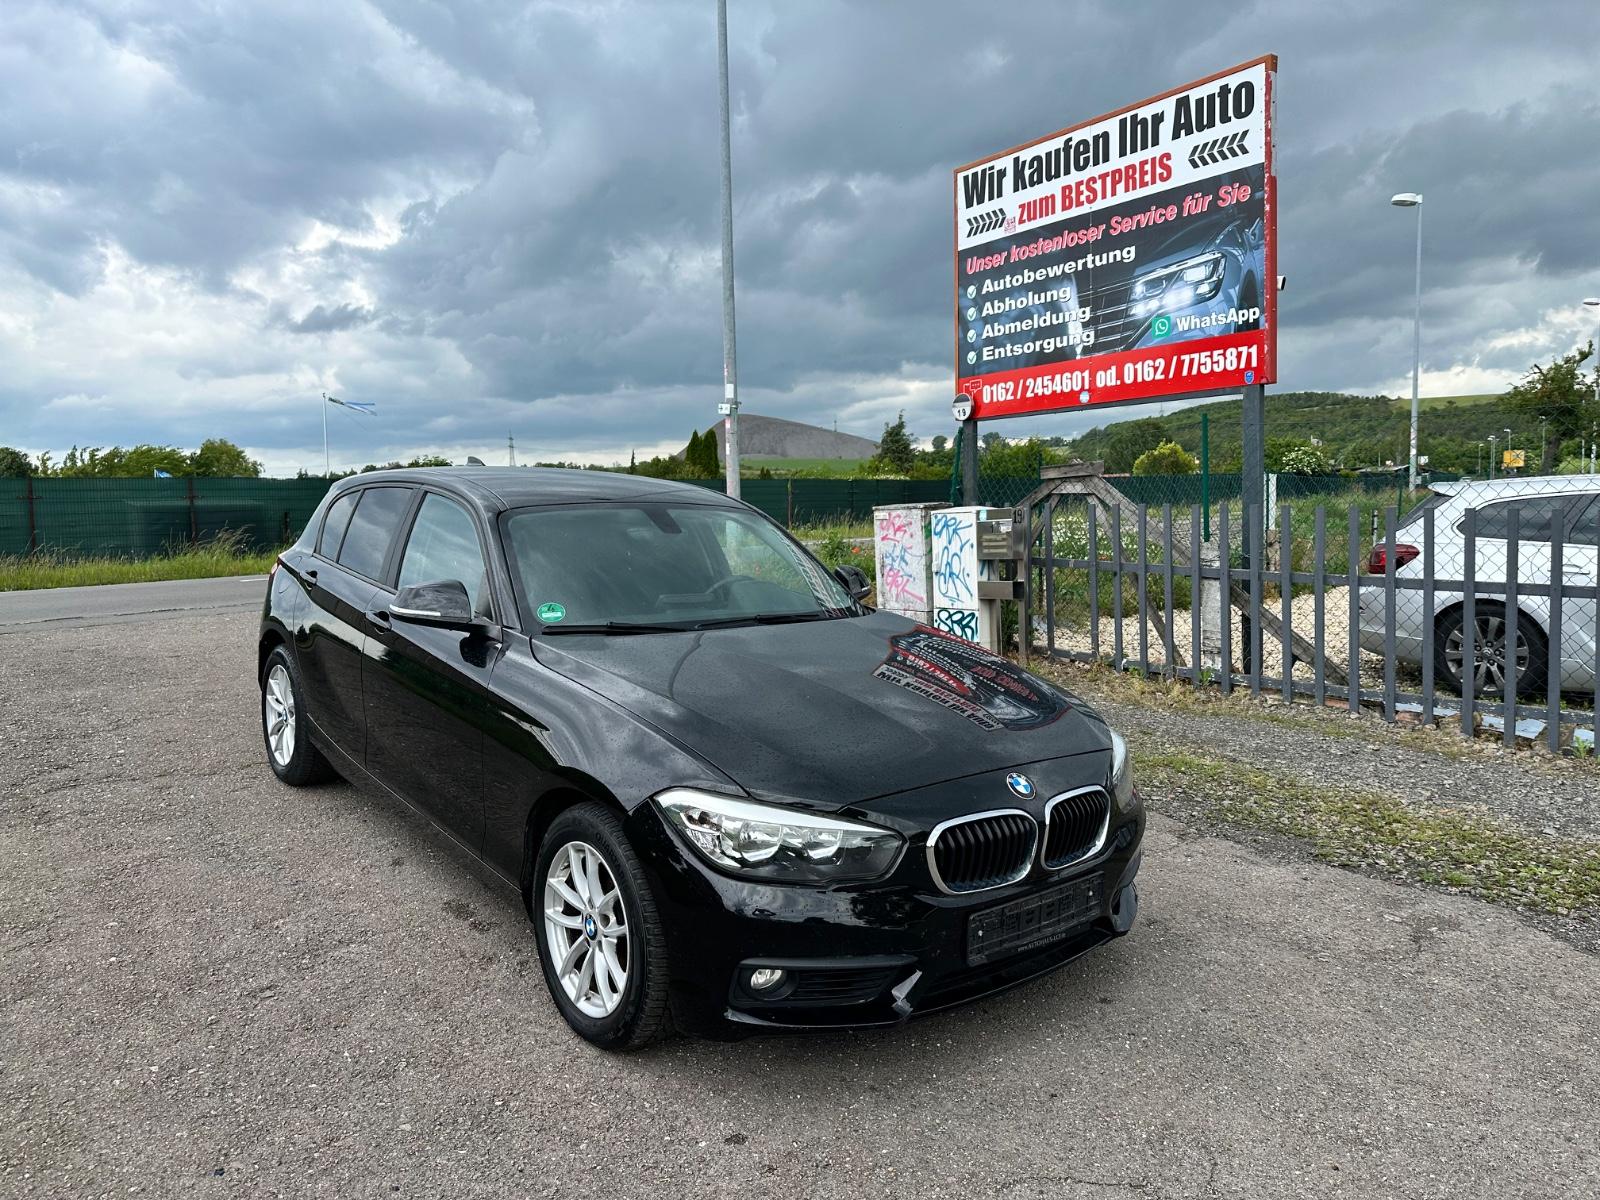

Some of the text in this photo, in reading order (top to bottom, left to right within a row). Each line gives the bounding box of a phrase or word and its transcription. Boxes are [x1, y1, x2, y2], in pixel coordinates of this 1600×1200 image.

[962, 80, 1255, 209] Wir kaufen Ihr Auto
[1018, 152, 1172, 225] zum BESTPREIS
[966, 248, 1008, 275] Unser
[1010, 224, 1105, 263] kostenloser
[1109, 202, 1177, 236] Service
[1182, 193, 1213, 218] für
[1217, 185, 1252, 208] Sie
[981, 245, 1136, 295] Autobewertung
[981, 284, 1072, 318] Abholung
[981, 305, 1091, 340] Abmeldung
[1176, 306, 1261, 333] WhatsApp
[982, 329, 1095, 361] Entsorgung
[982, 384, 1015, 403] 0162
[1026, 369, 1090, 398] 2454601
[1096, 365, 1121, 388] od.
[1123, 357, 1165, 382] 0162
[1181, 344, 1258, 373] 7755871
[957, 408, 967, 417] 19
[1013, 508, 1023, 523] 19
